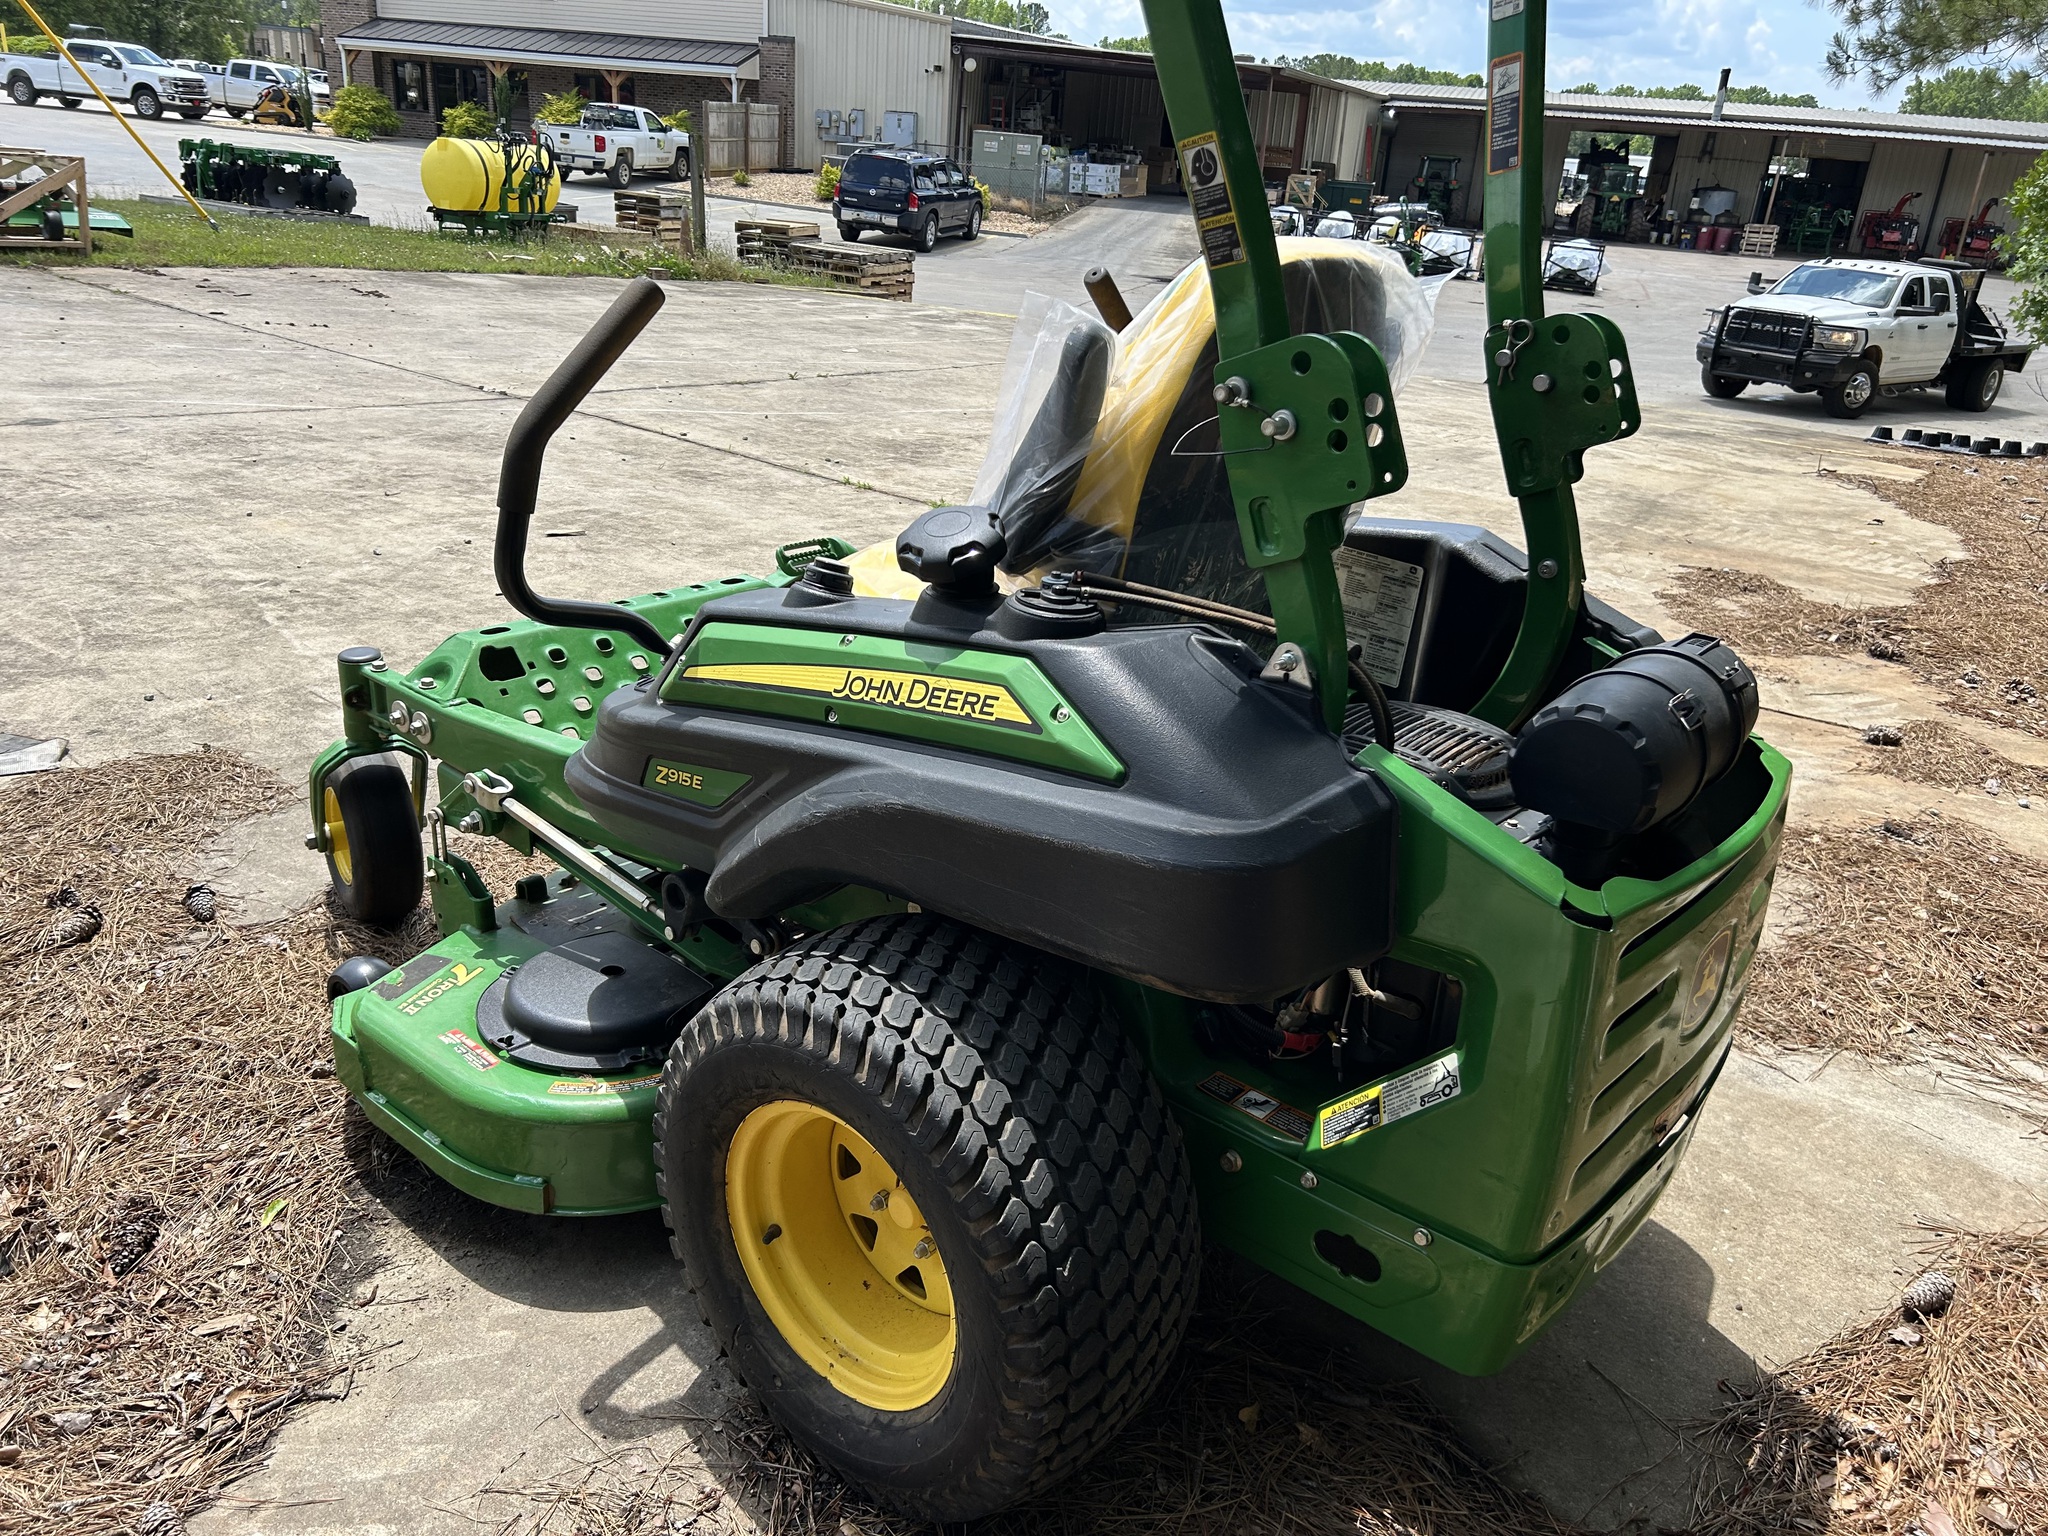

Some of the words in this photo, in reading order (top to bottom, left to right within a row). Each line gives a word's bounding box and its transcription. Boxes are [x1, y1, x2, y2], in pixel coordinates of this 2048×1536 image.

[1186, 133, 1214, 147] CAUTION
[833, 670, 904, 702] JOHN
[906, 679, 1000, 717] DEERE
[1337, 1092, 1370, 1112] ATENCIÓN
